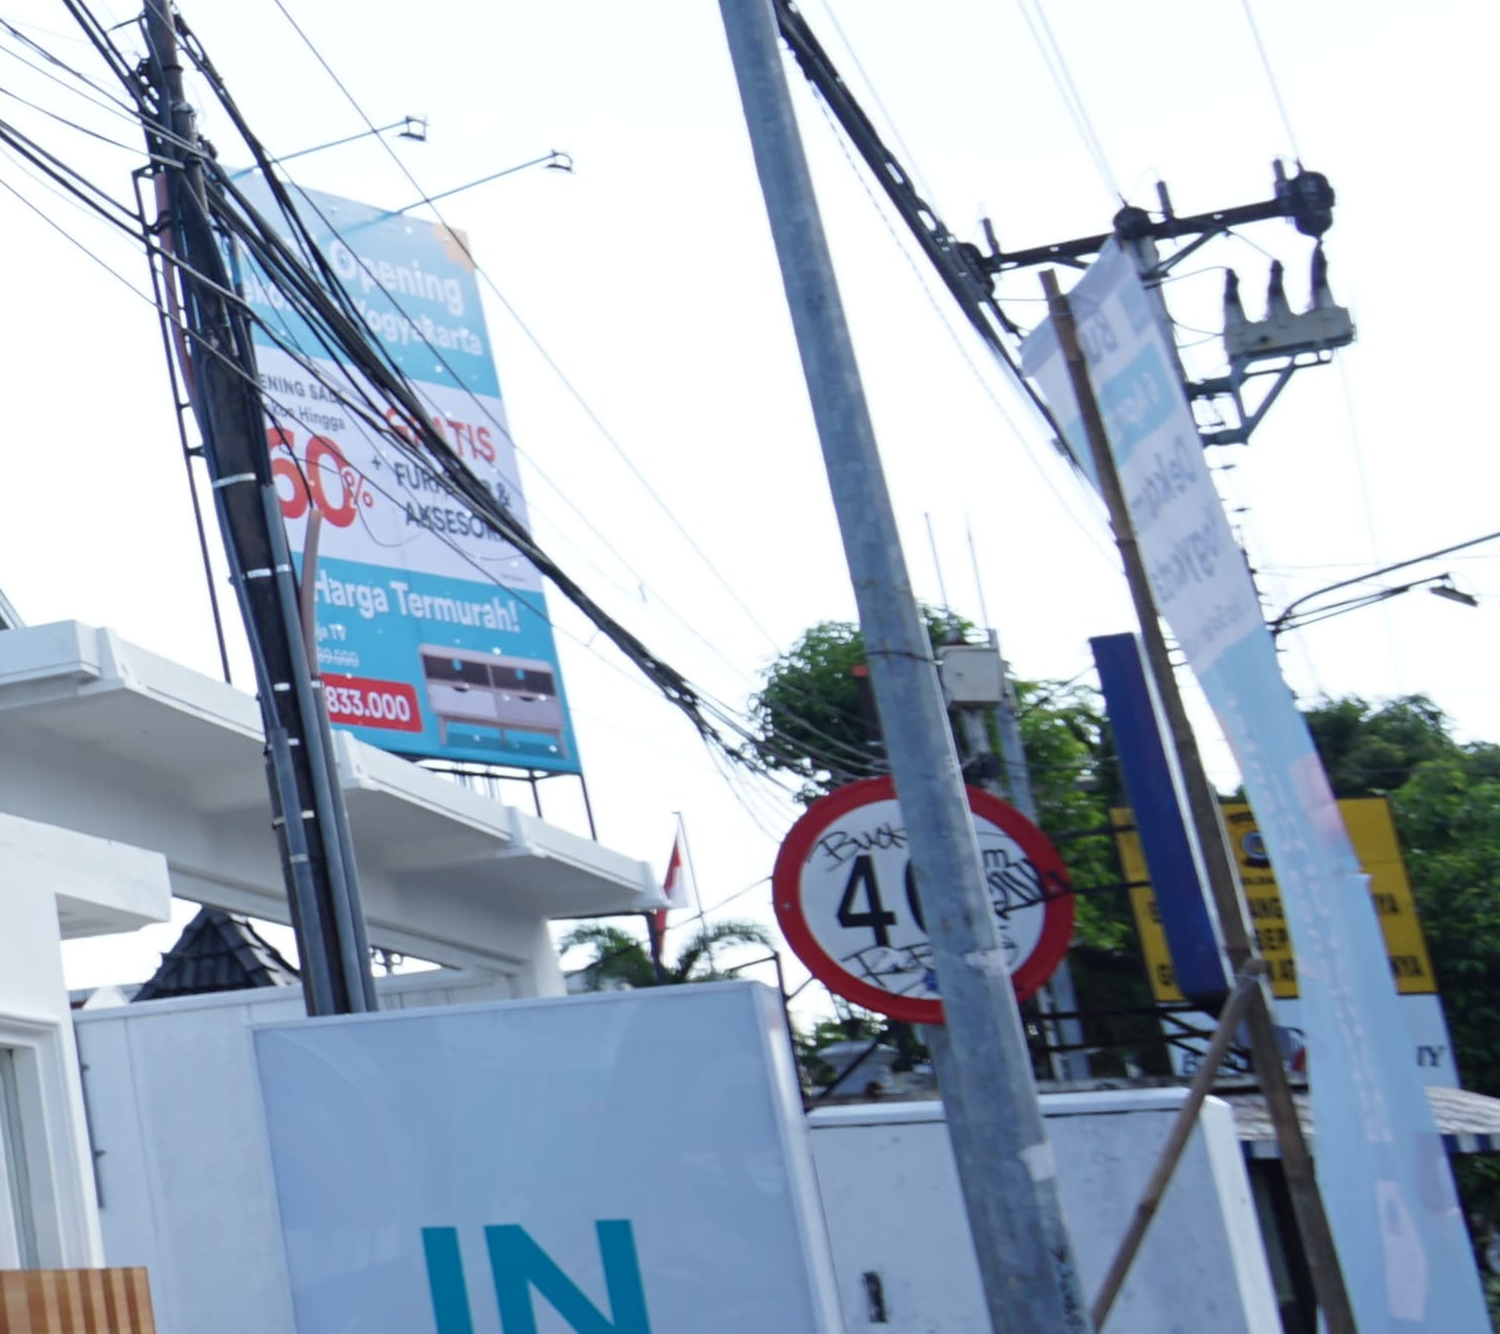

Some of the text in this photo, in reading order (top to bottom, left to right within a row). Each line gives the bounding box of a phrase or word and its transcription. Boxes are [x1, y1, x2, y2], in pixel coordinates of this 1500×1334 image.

[328, 239, 465, 316] Opening
[314, 570, 520, 633] Harga Termurah!
